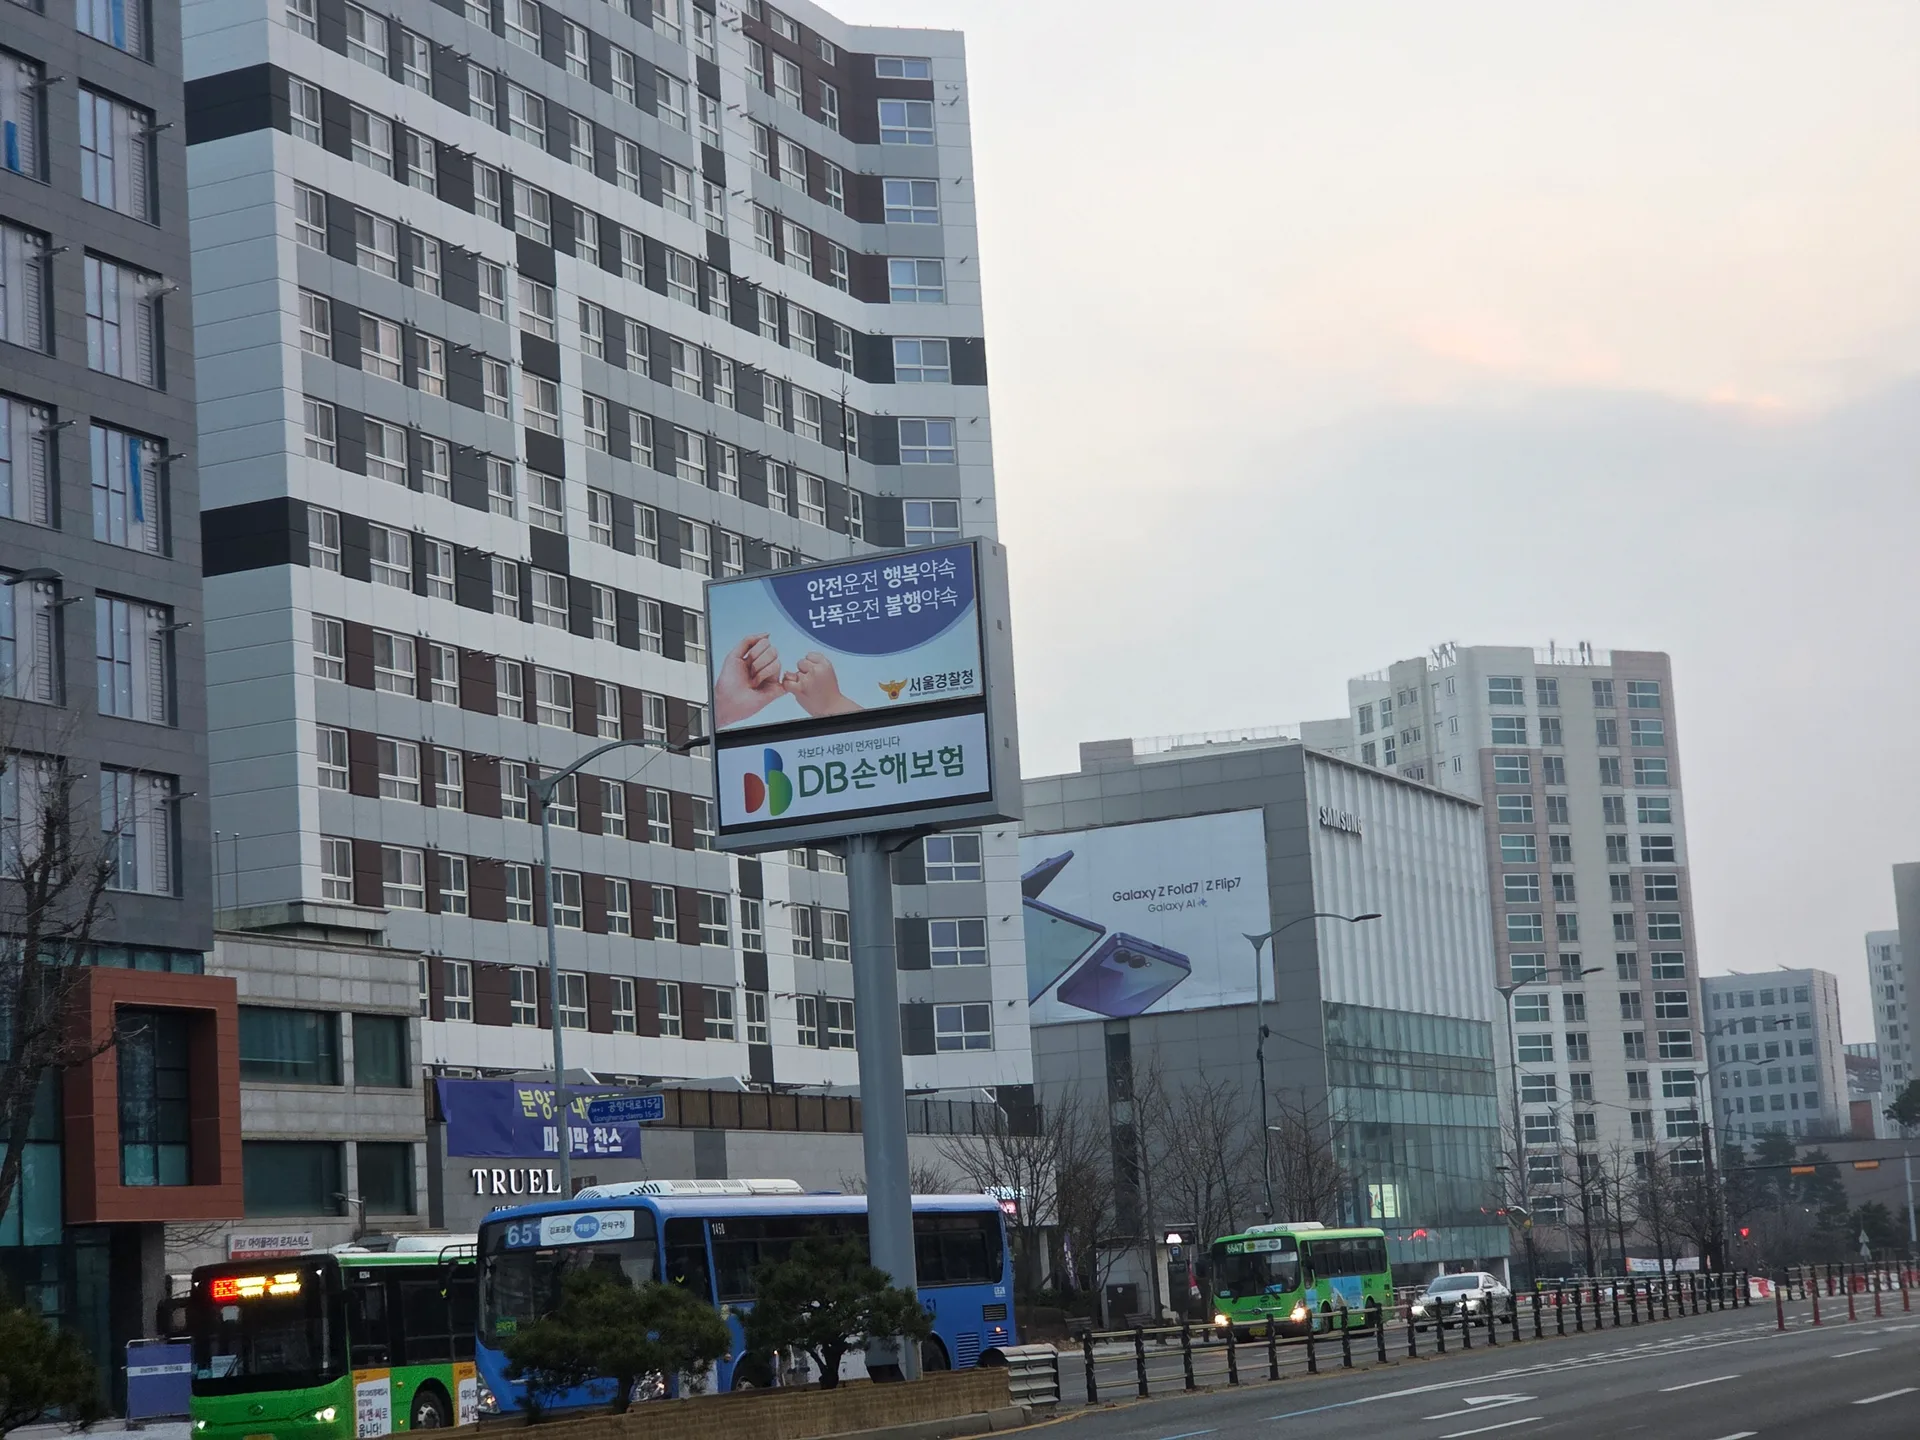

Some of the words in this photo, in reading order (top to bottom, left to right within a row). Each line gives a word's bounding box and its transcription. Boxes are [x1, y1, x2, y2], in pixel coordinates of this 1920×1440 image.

[807, 569, 878, 601] 안전운전
[882, 558, 957, 588] 행복약속
[808, 597, 880, 629] 난폭운전
[885, 586, 958, 617] 불행약속
[909, 669, 974, 692] 서울경찰청
[797, 746, 825, 759] 차보다
[826, 741, 854, 755] 사람이
[856, 736, 901, 752] 먼저입니다
[798, 745, 964, 798] DB손해보험
[1112, 889, 1156, 902] Galaxy
[1158, 886, 1166, 897] Z
[1167, 881, 1200, 896] Fold7
[1206, 880, 1213, 891] Z
[1215, 876, 1242, 892] Flip7
[1147, 902, 1184, 912] Galaxy
[1186, 899, 1196, 909] AI
[593, 1127, 623, 1153] 찬스
[472, 1168, 562, 1195] TRUEL
